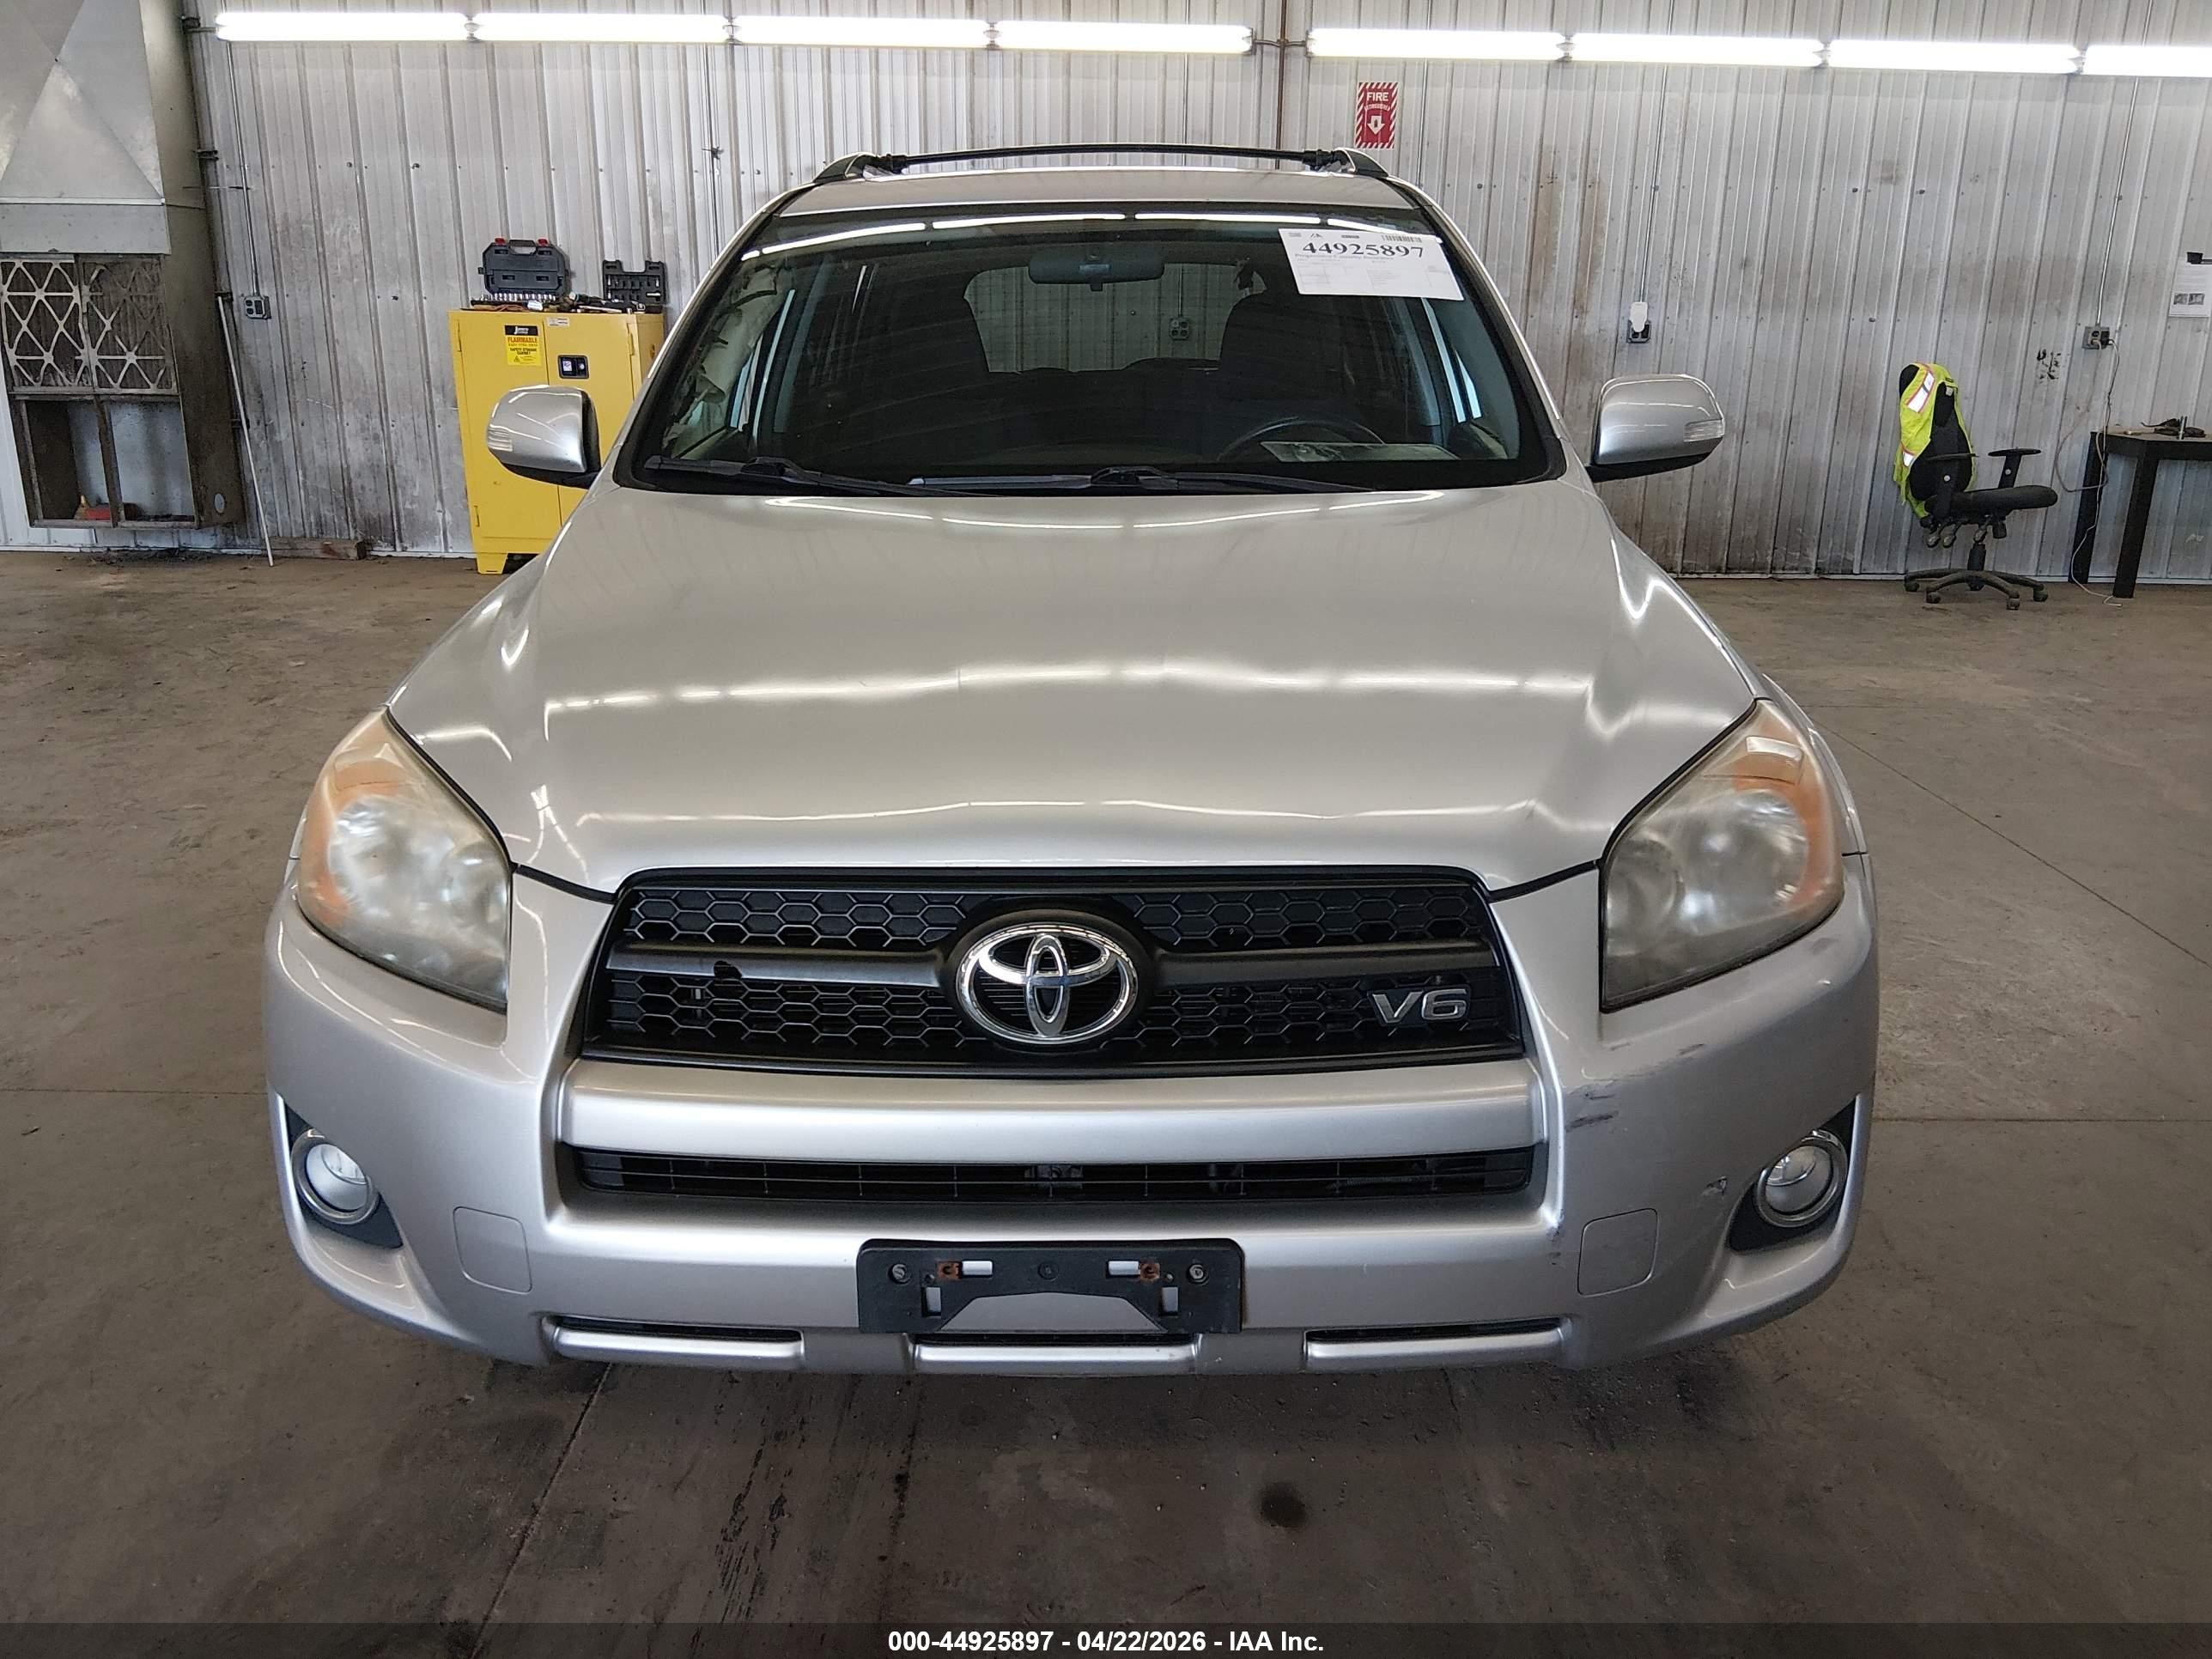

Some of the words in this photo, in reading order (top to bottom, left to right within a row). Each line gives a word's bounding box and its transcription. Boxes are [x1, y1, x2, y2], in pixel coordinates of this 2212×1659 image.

[1366, 91, 1389, 101] FIRE
[1302, 242, 1424, 258] 44925897
[1371, 988, 1468, 1024] V6
